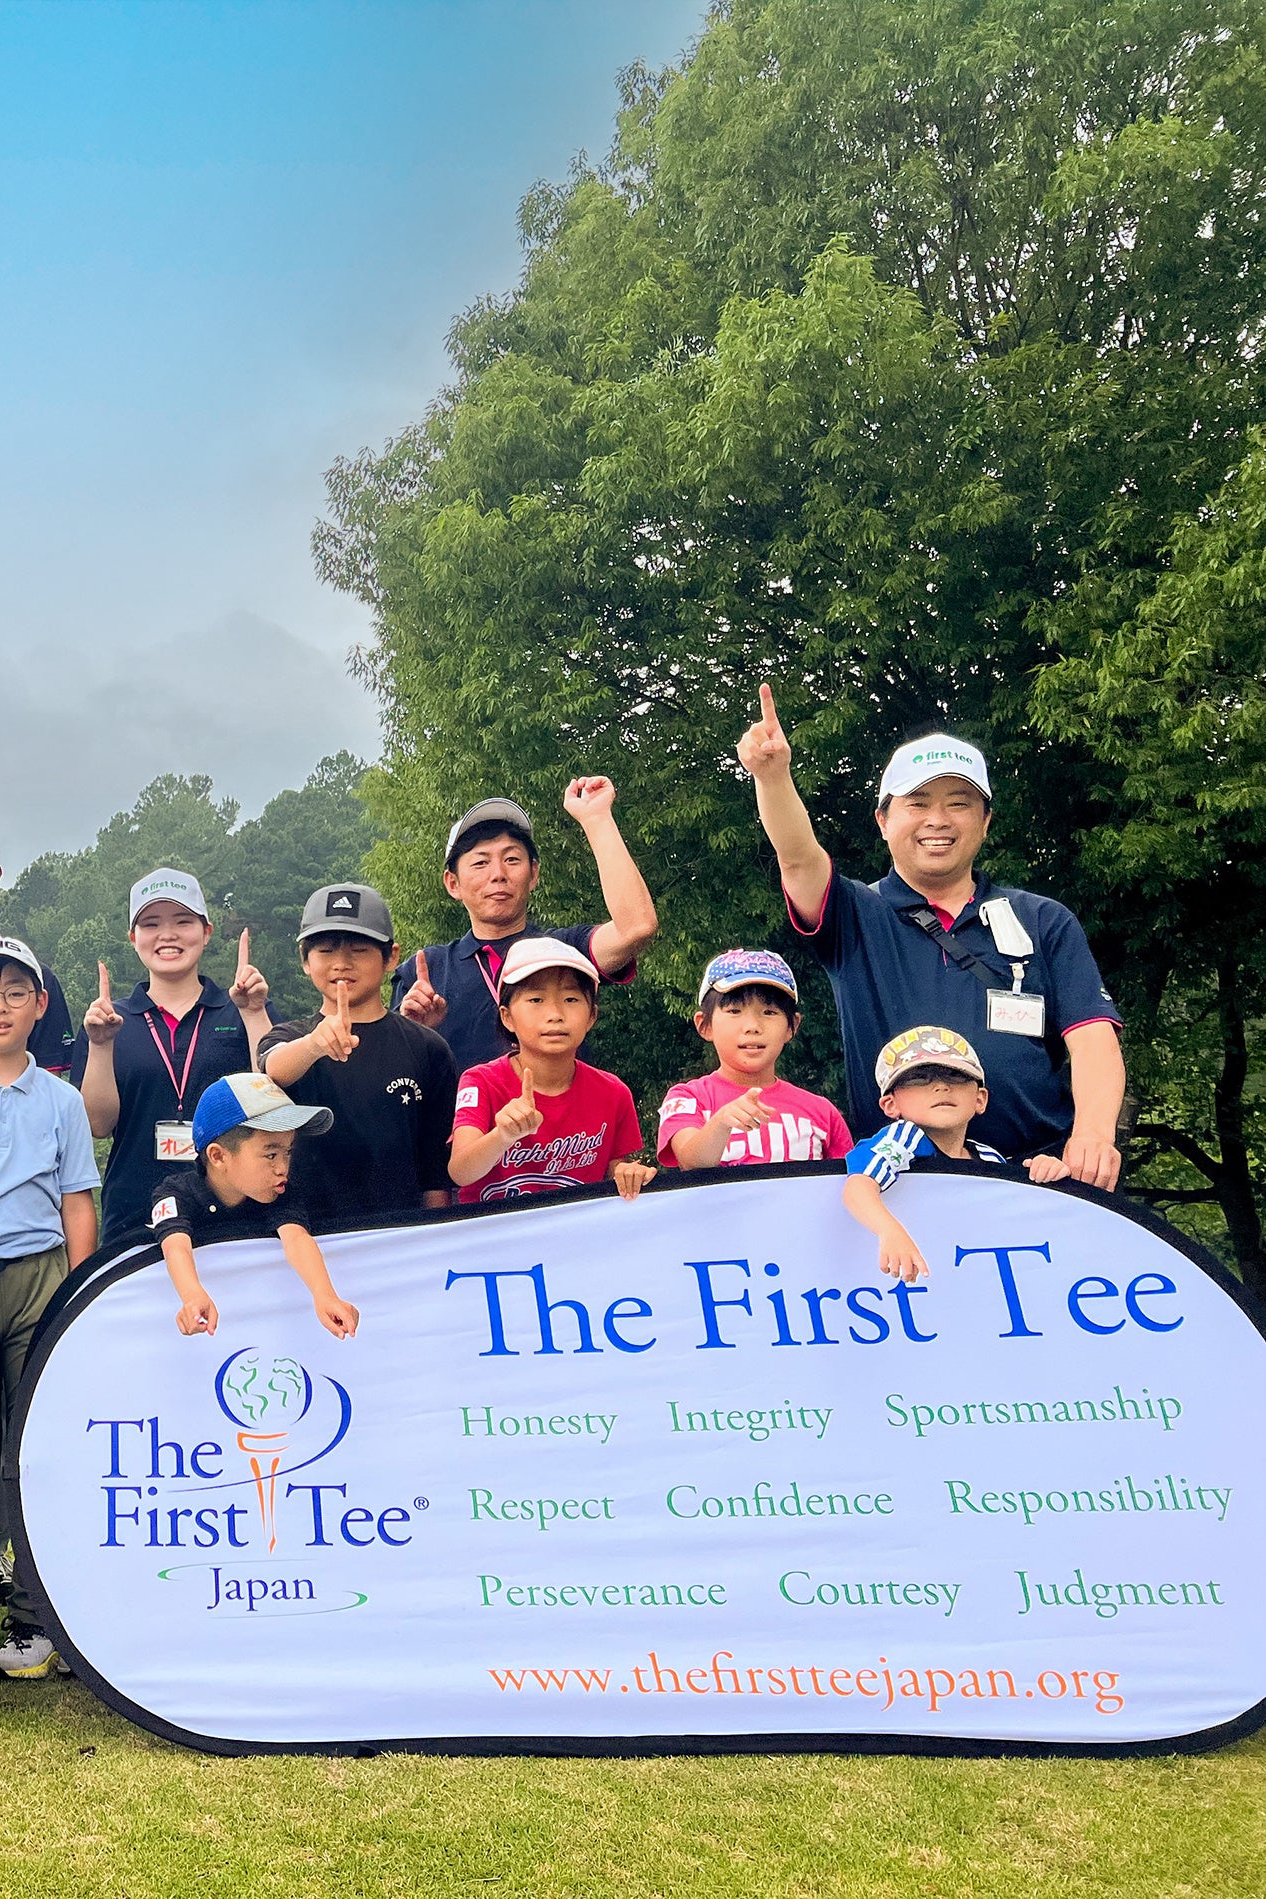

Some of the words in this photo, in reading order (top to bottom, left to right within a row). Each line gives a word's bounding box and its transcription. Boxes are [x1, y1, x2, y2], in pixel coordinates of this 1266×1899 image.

[926, 751, 953, 760] first
[955, 752, 973, 765] tee
[150, 881, 169, 891] first
[170, 881, 187, 890] tee
[386, 1078, 422, 1101] CONVERSE
[552, 1122, 608, 1159] Mind
[445, 1262, 657, 1357] The
[683, 1258, 938, 1350] First
[954, 1241, 1185, 1338] Tee
[459, 1405, 618, 1445] Honesty
[666, 1399, 834, 1442] Integrity
[885, 1384, 1183, 1438] Sportsmanship
[86, 1416, 224, 1479] The
[99, 1485, 250, 1548] First
[467, 1487, 616, 1531] Respect
[666, 1481, 895, 1519] Confidence
[943, 1474, 1233, 1526] Responsibility
[207, 1567, 317, 1612] Japan
[476, 1574, 728, 1607] Perseverance
[778, 1570, 963, 1617] Courtesy
[1014, 1568, 1226, 1618] Judgment
[486, 1651, 1125, 1715] www.thefirstteejapan.org
